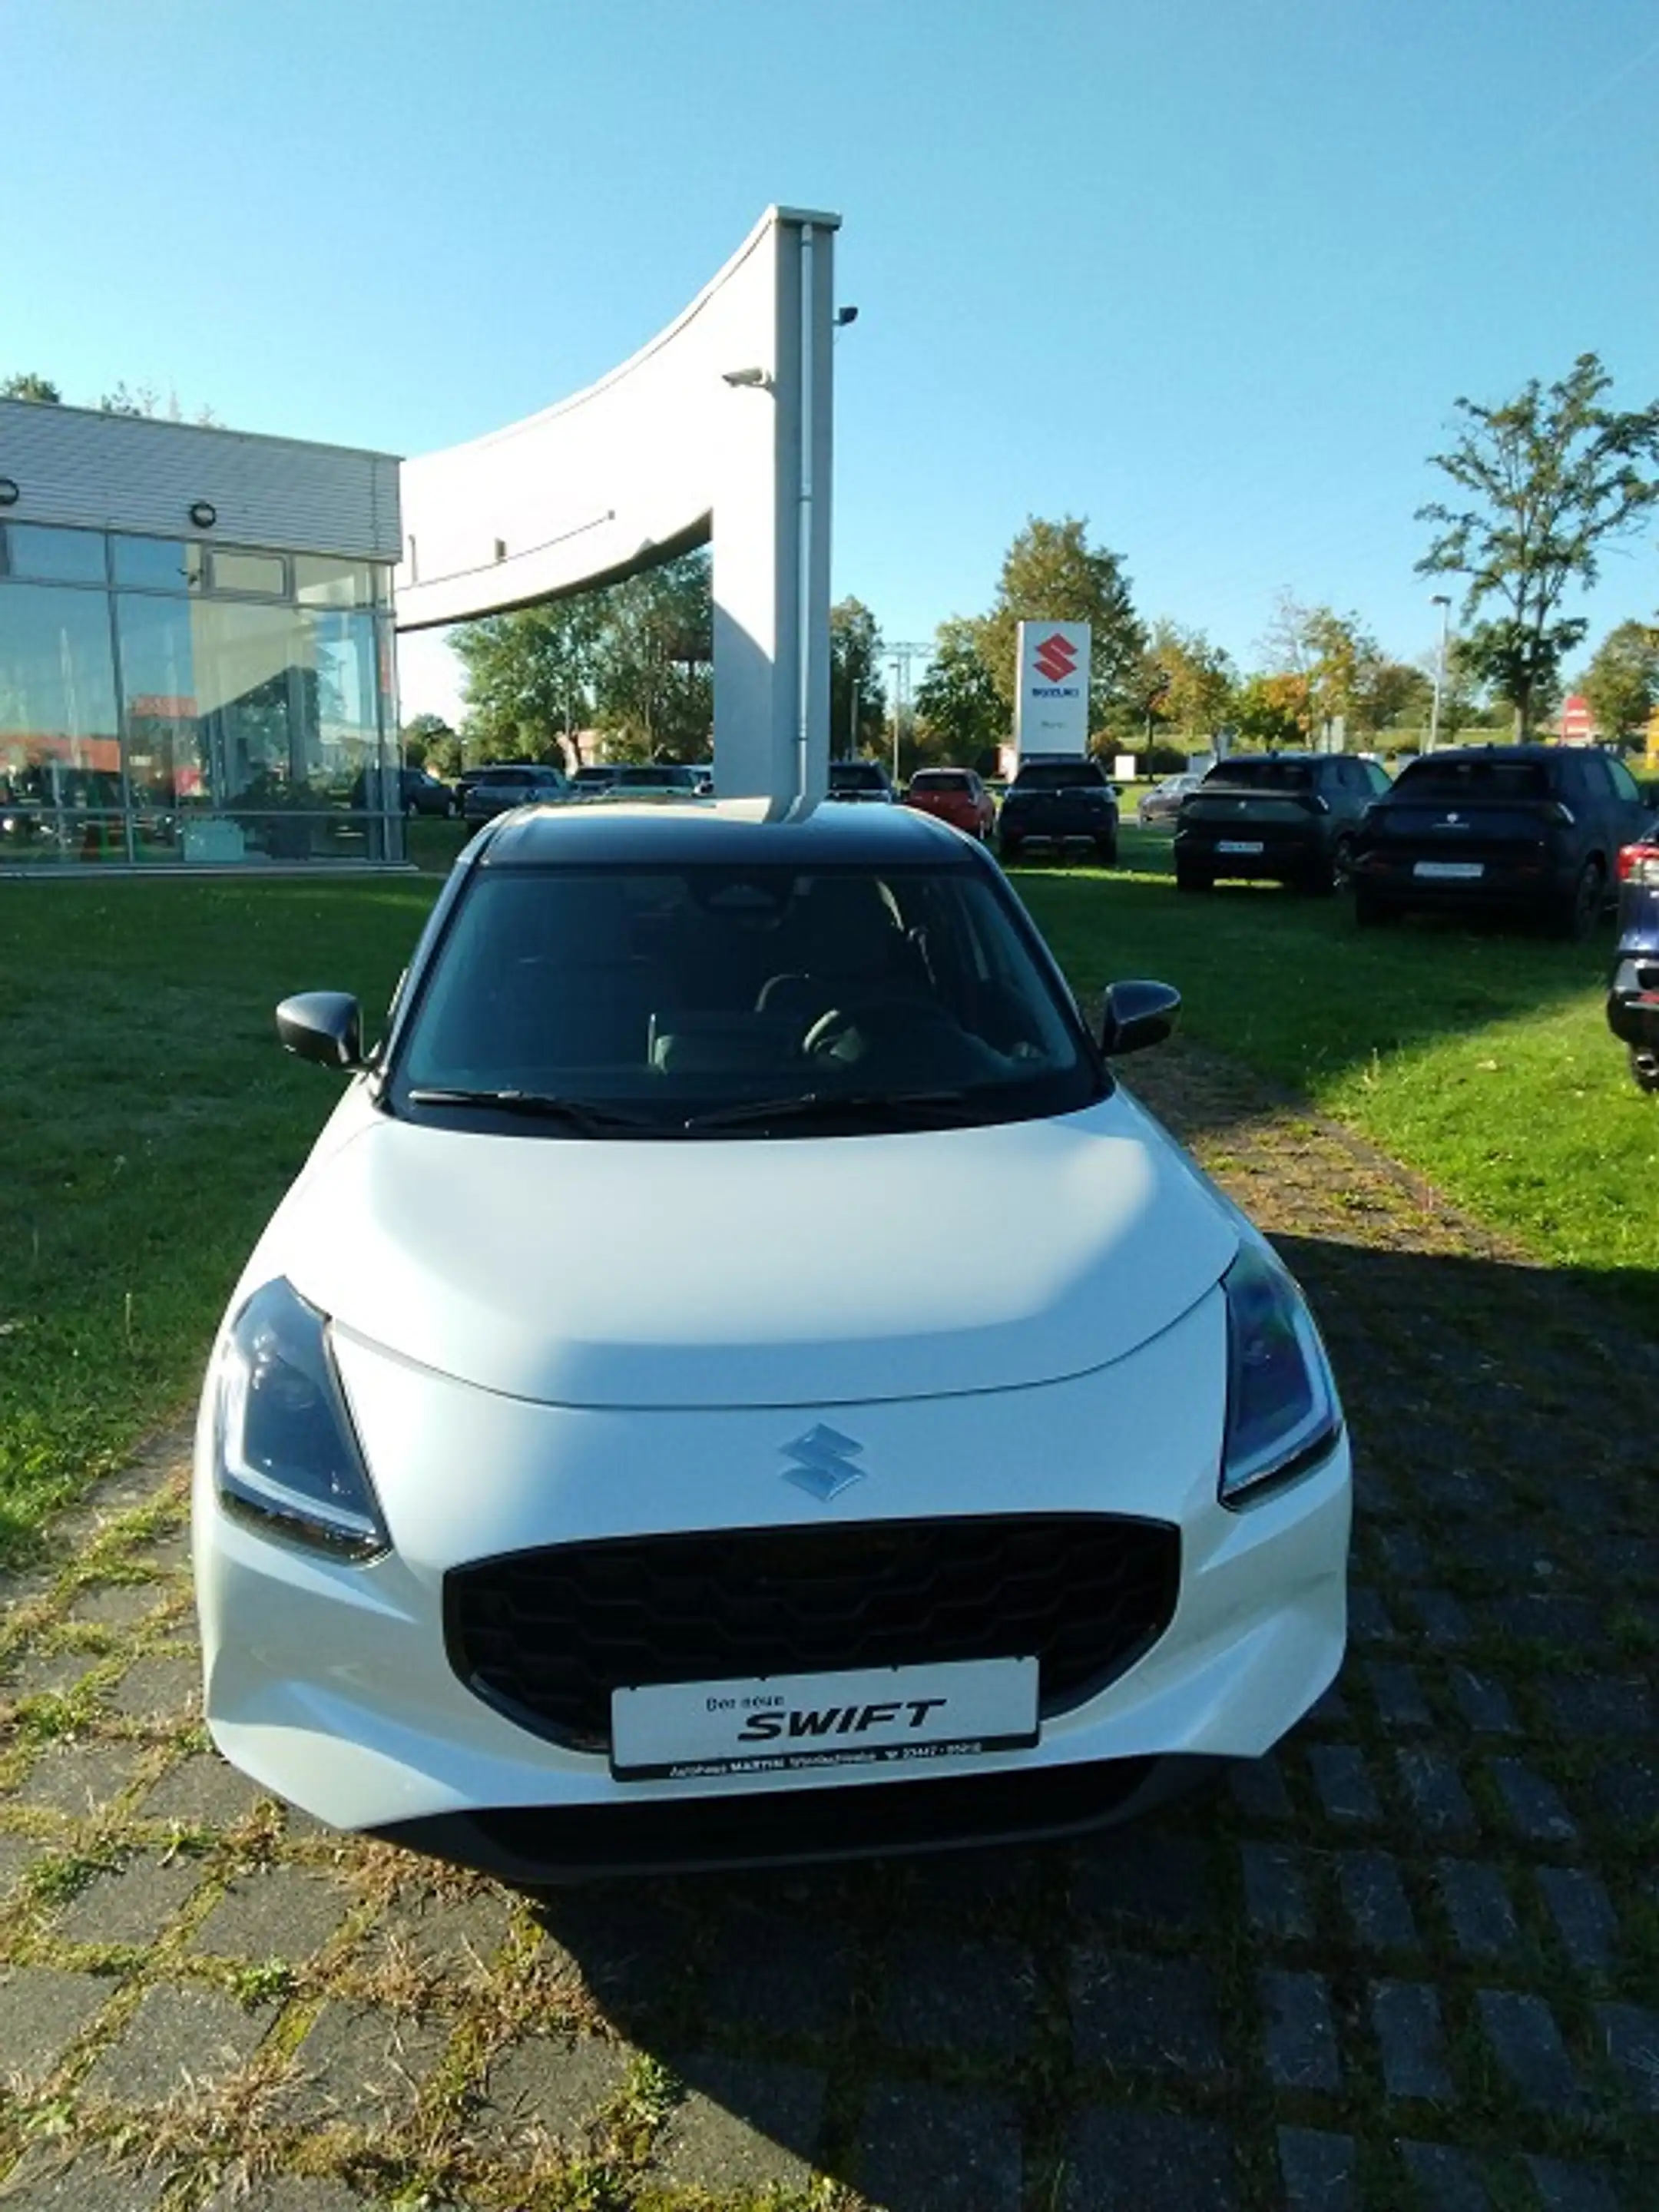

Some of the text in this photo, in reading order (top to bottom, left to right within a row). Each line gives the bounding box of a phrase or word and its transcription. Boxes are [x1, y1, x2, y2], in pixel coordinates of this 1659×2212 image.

[707, 1695, 784, 1711] Der neue
[737, 1698, 946, 1742] SWIFT
[730, 1757, 785, 1772] MARTIN
